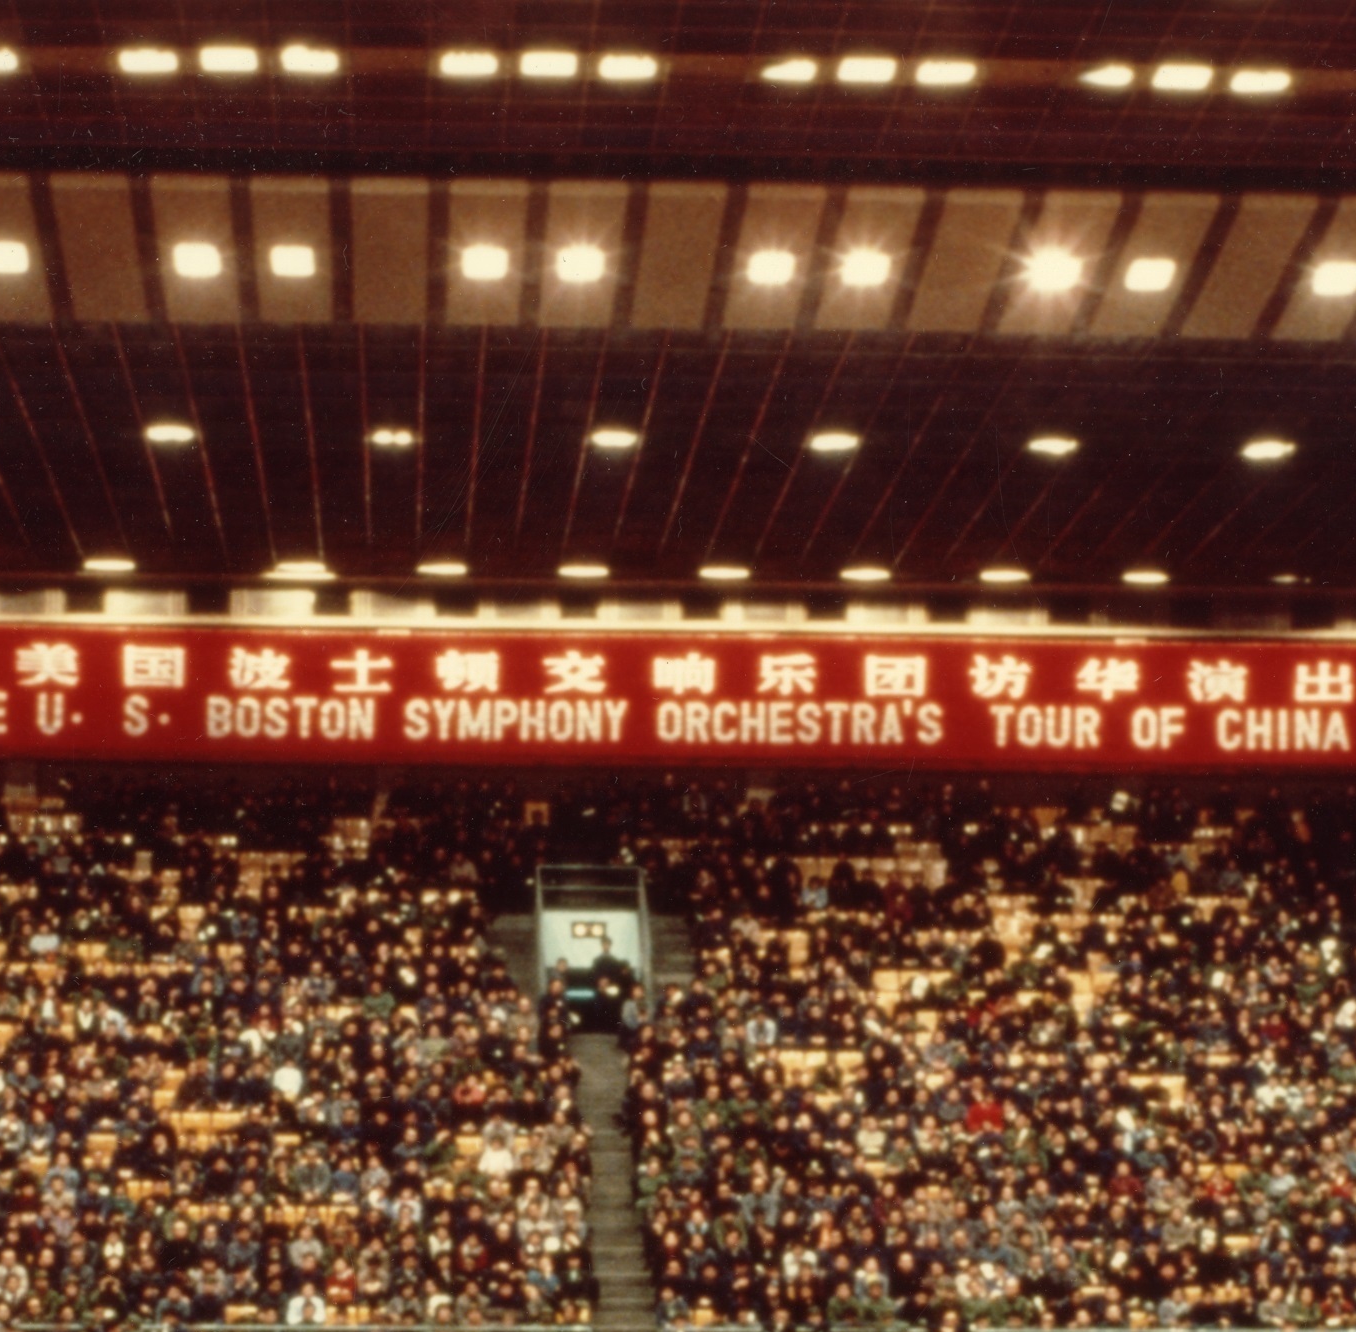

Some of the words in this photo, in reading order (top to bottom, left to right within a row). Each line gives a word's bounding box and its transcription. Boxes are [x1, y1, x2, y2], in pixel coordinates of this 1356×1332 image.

[207, 694, 376, 739] BOSTON
[404, 697, 628, 742] SYMPHONY
[656, 699, 943, 744] ORCHESTRA'S
[989, 703, 1102, 749] TOUR
[1130, 705, 1186, 750] OF
[1216, 707, 1350, 751] CHINA
